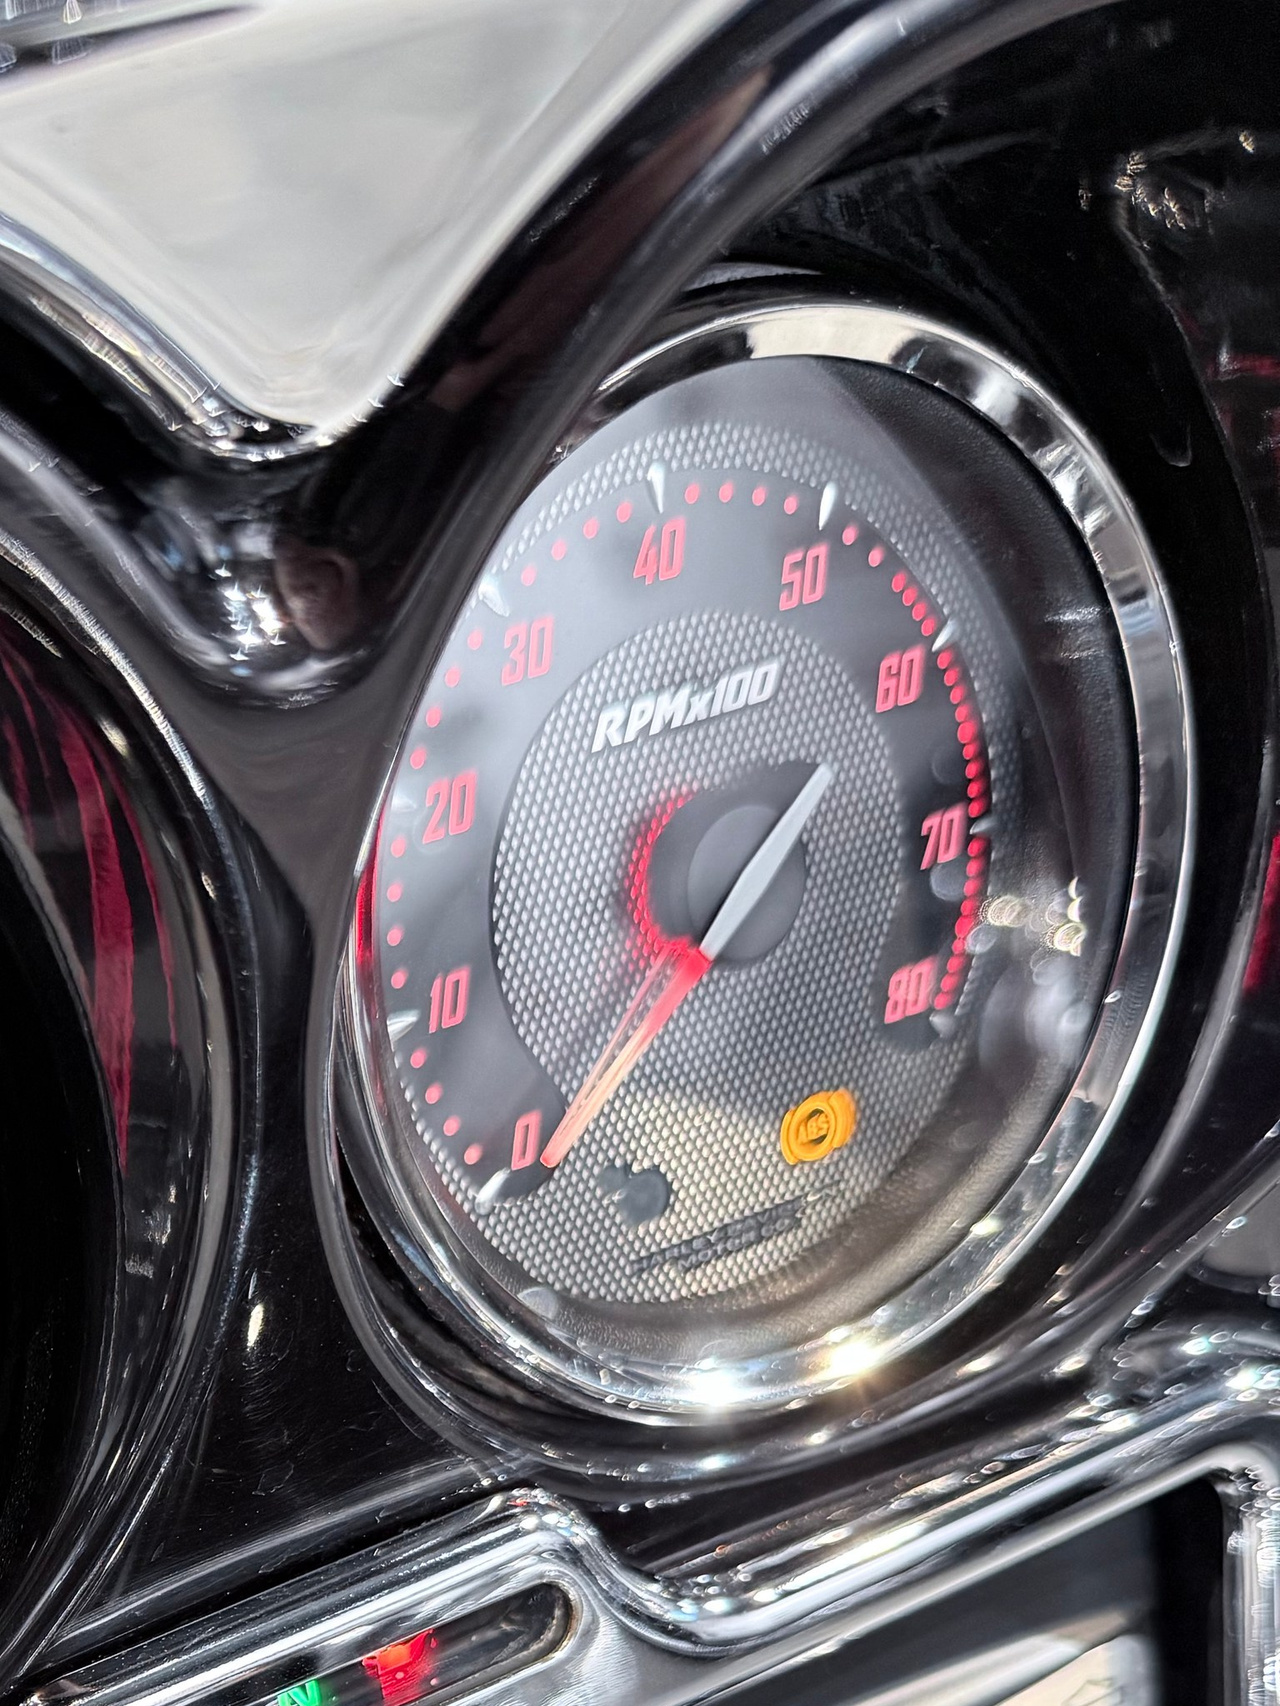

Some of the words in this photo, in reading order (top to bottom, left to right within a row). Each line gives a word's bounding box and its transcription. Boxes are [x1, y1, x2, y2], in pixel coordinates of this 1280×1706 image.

[633, 516, 686, 585] 40
[779, 544, 830, 611] 50
[501, 616, 554, 686] 30
[876, 647, 926, 713] 60
[422, 771, 478, 844] 20
[920, 802, 967, 870] 70
[429, 966, 471, 1034] 10
[884, 957, 937, 1024] 80
[511, 1110, 542, 1171] 0
